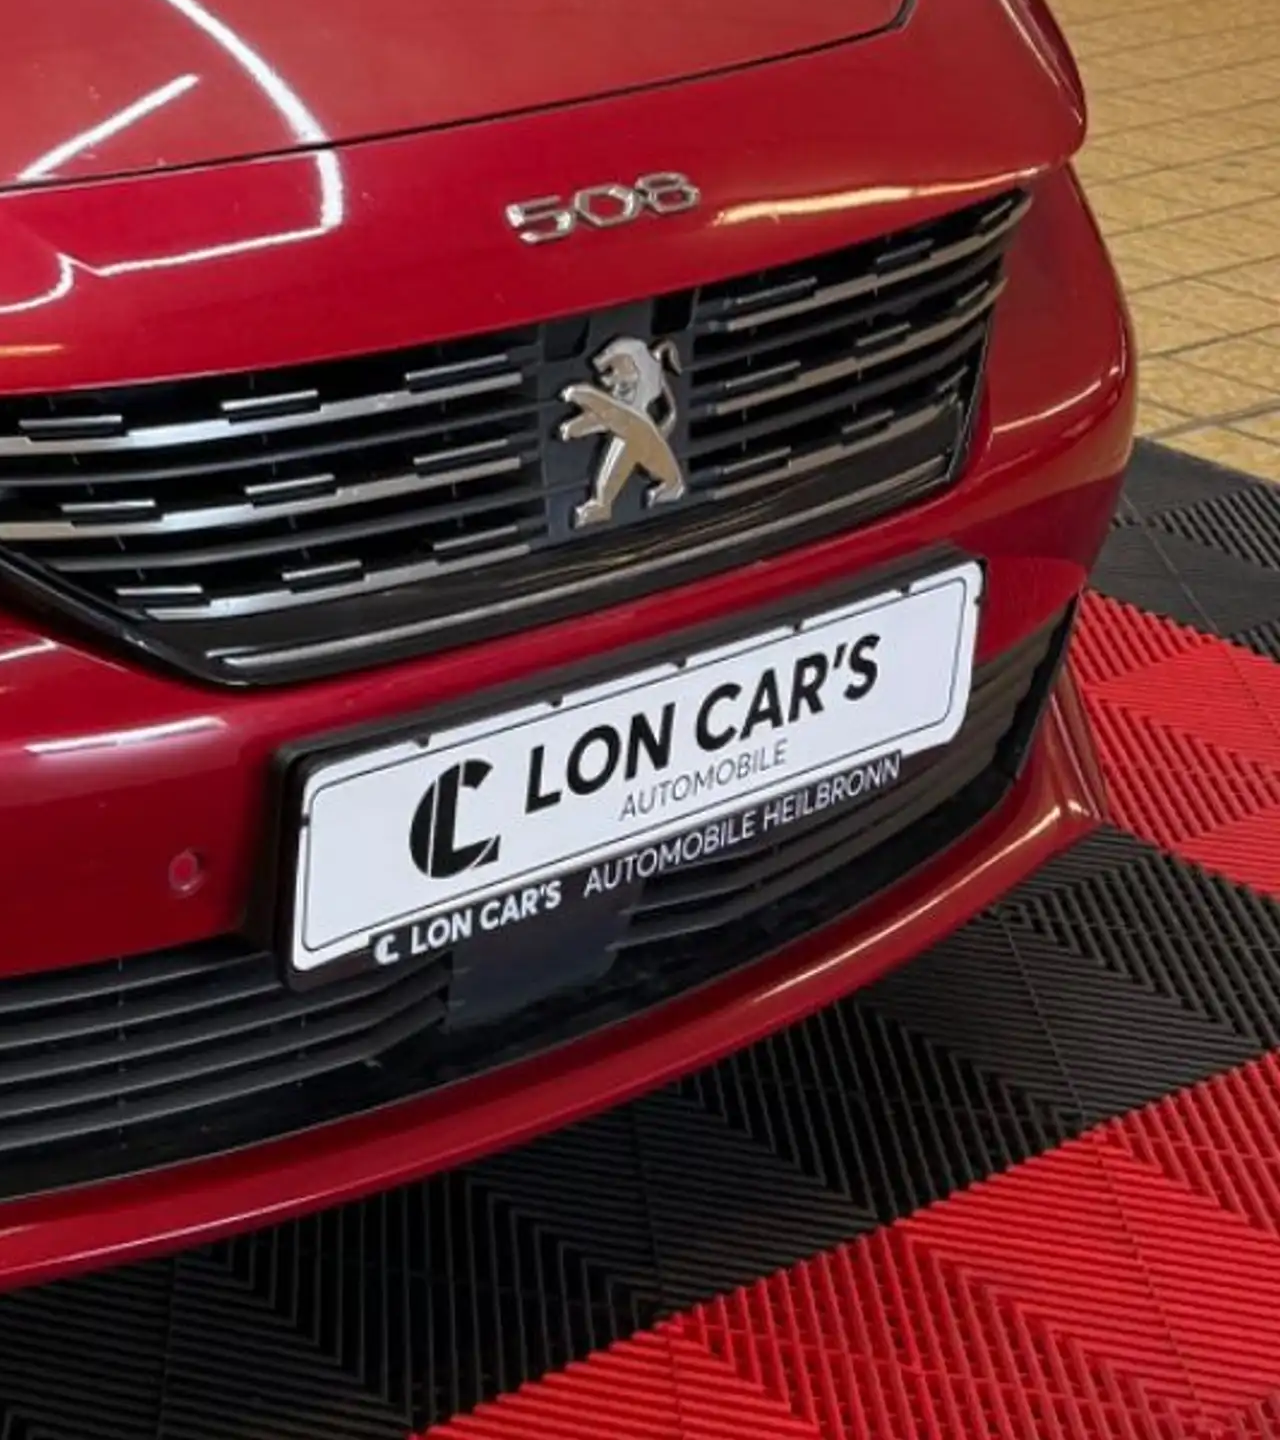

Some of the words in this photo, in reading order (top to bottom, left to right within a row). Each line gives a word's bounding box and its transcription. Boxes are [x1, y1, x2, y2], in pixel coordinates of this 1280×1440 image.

[505, 172, 702, 245] 508
[524, 702, 676, 814] LON
[695, 633, 881, 751] CAR'S
[618, 738, 789, 821] AUTOMOBILE
[410, 908, 473, 955] LON
[479, 880, 562, 930] CAR'S
[583, 810, 756, 898] AUTOMOBILE
[762, 754, 903, 832] HEILBRONN
